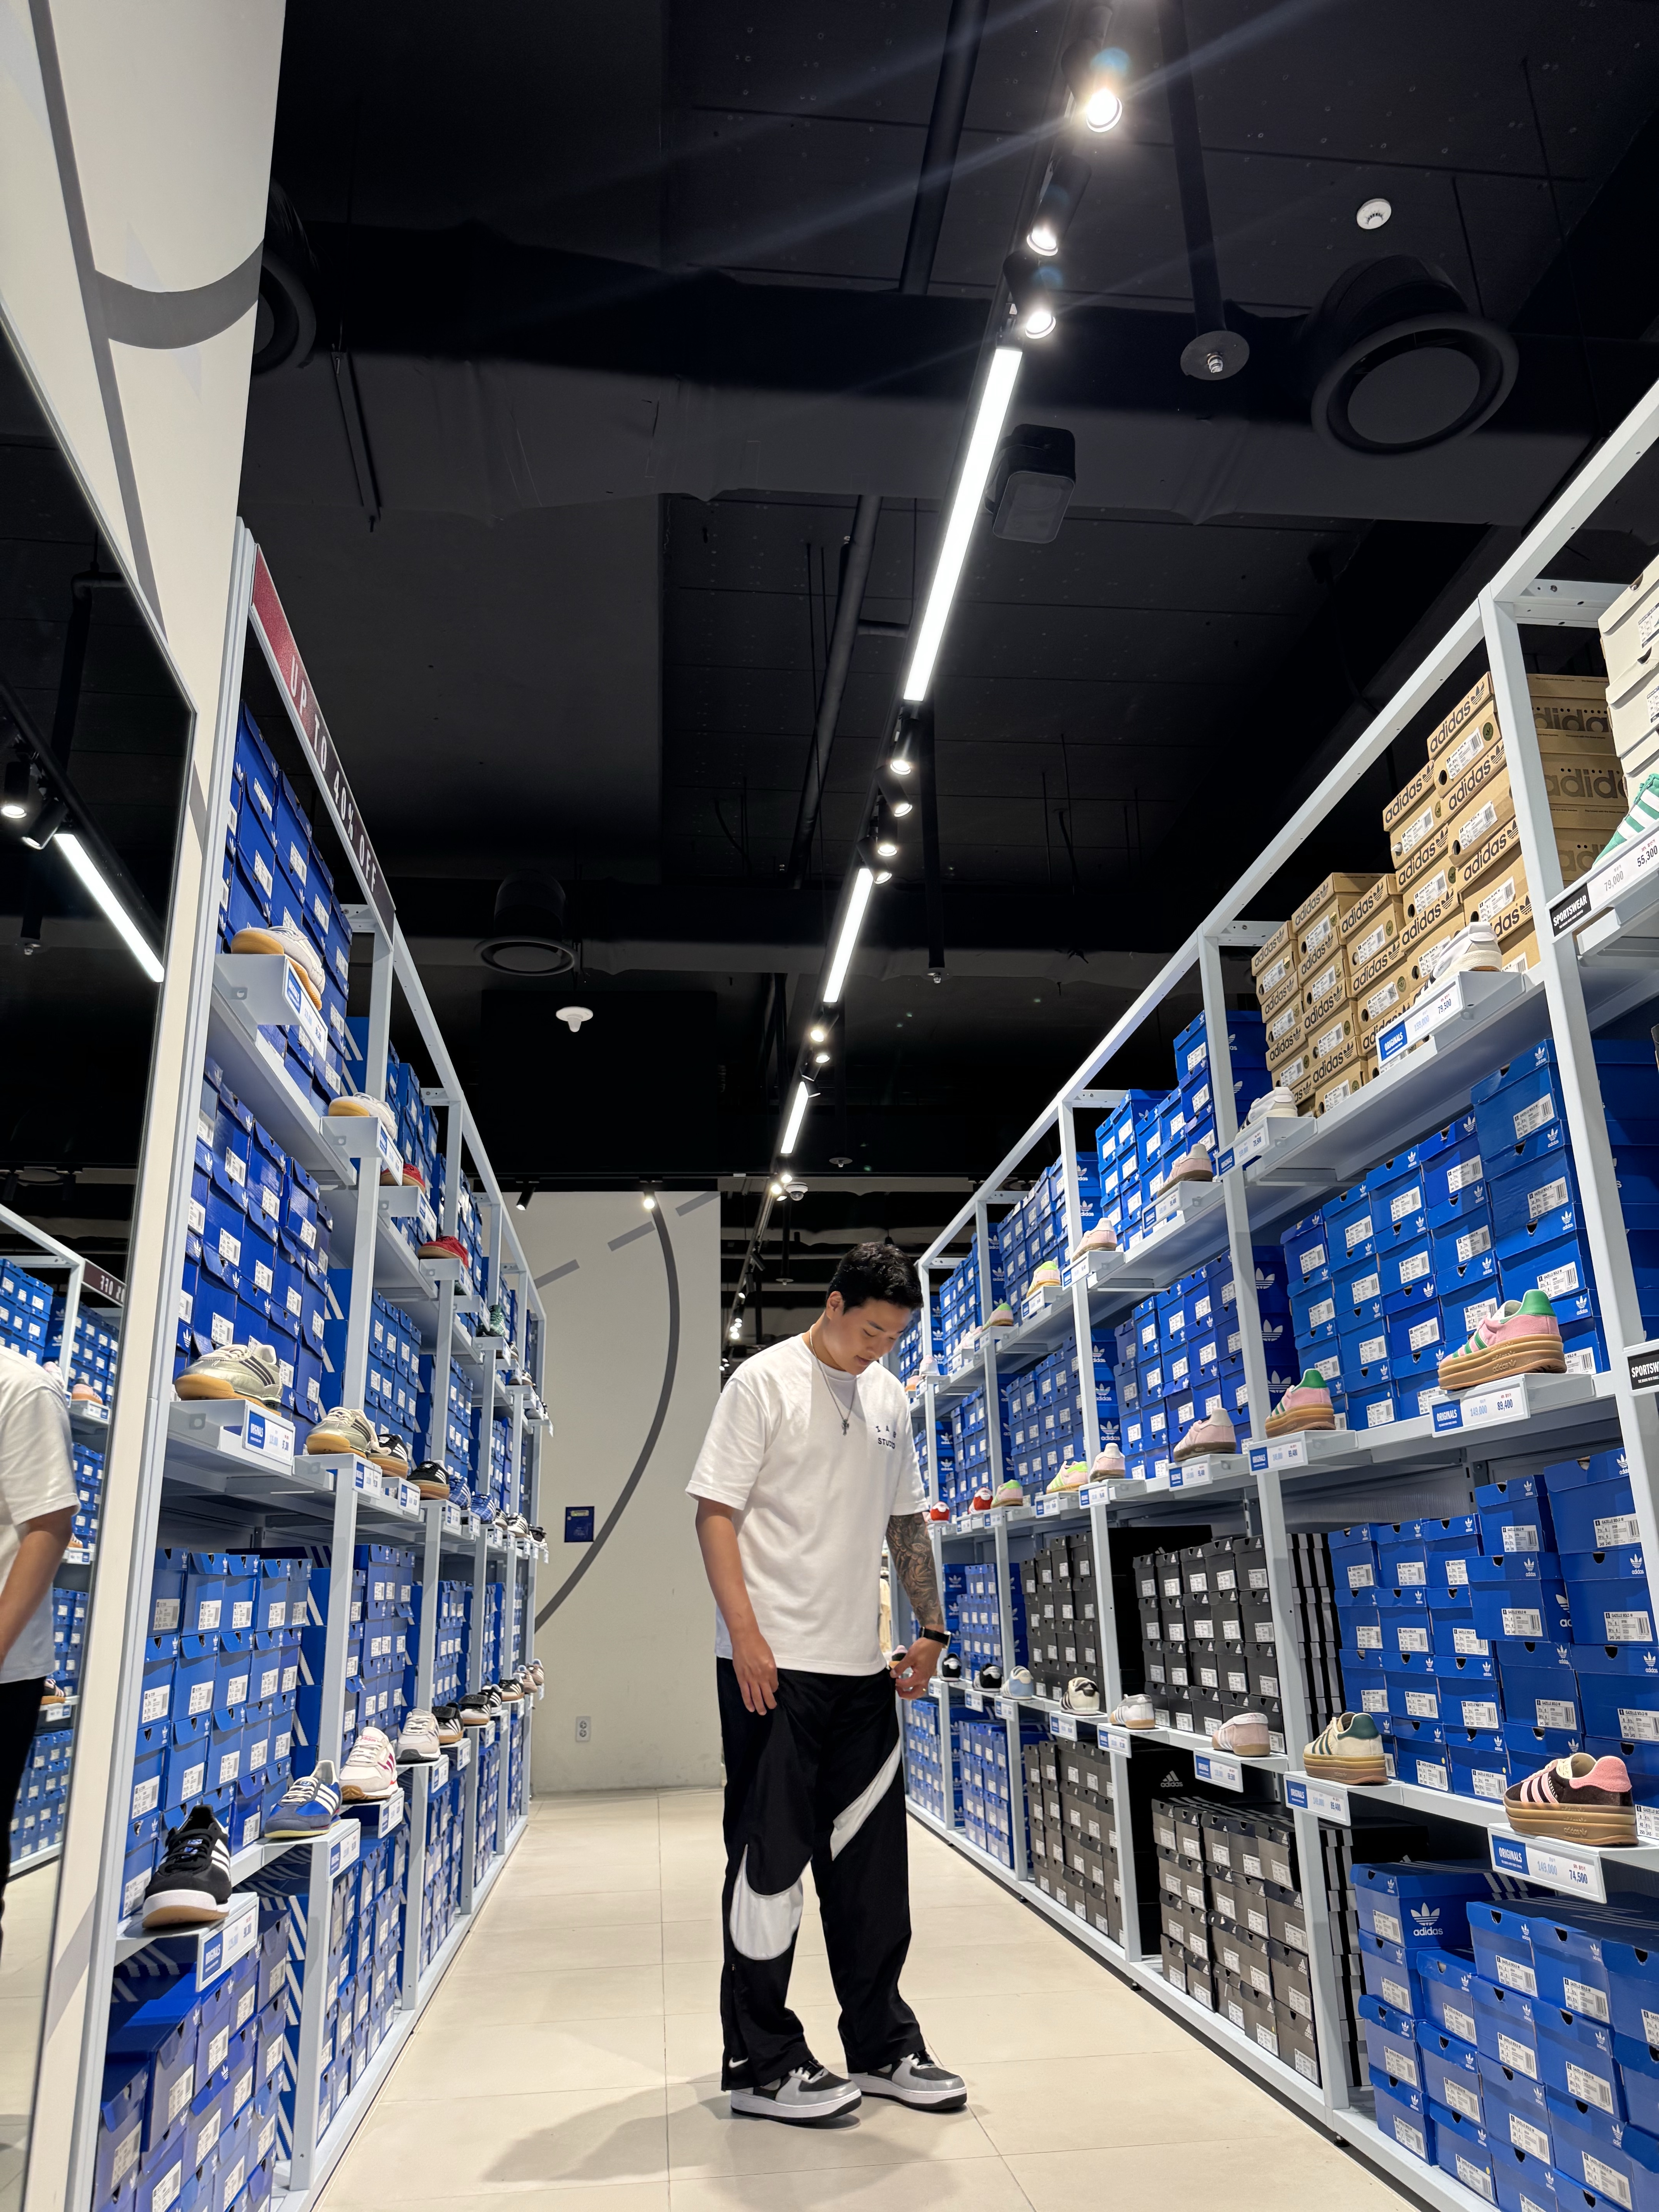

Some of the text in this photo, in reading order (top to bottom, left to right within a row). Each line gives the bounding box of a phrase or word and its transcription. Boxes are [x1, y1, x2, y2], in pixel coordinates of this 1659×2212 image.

[1430, 700, 1471, 753] adidas
[290, 655, 377, 892] UP TO 40% OFF
[1449, 759, 1490, 810] adidas
[1386, 778, 1422, 823] adidas
[1398, 843, 1435, 886] adidas
[1464, 834, 1506, 881] adidas
[1553, 895, 1587, 926] SPORTSWEAR
[1604, 871, 1624, 891] 79,000
[1637, 845, 1658, 867] 55,300
[1295, 896, 1320, 926] adidas
[1342, 896, 1373, 933] adidas
[1402, 905, 1441, 945] adidas
[1255, 938, 1276, 967] adidas
[1302, 945, 1326, 975] adidas
[1353, 955, 1388, 991] adidas
[1265, 985, 1287, 1015] adidas
[1304, 996, 1334, 1029] adidas
[1384, 1032, 1403, 1051] ORIGINALS
[1438, 998, 1451, 1014] 79,500
[1270, 1035, 1293, 1061] adidas
[1313, 1052, 1343, 1083] adidas
[1631, 1361, 1659, 1378] SPORTSW
[1437, 1399, 1513, 1422] ORIGINALS 149,000 89,400
[1499, 1847, 1522, 1863] ORIGINALS
[1537, 1861, 1558, 1875] 149,000
[1569, 1870, 1588, 1884] 74,500
[1413, 1927, 1443, 1936] adidas
